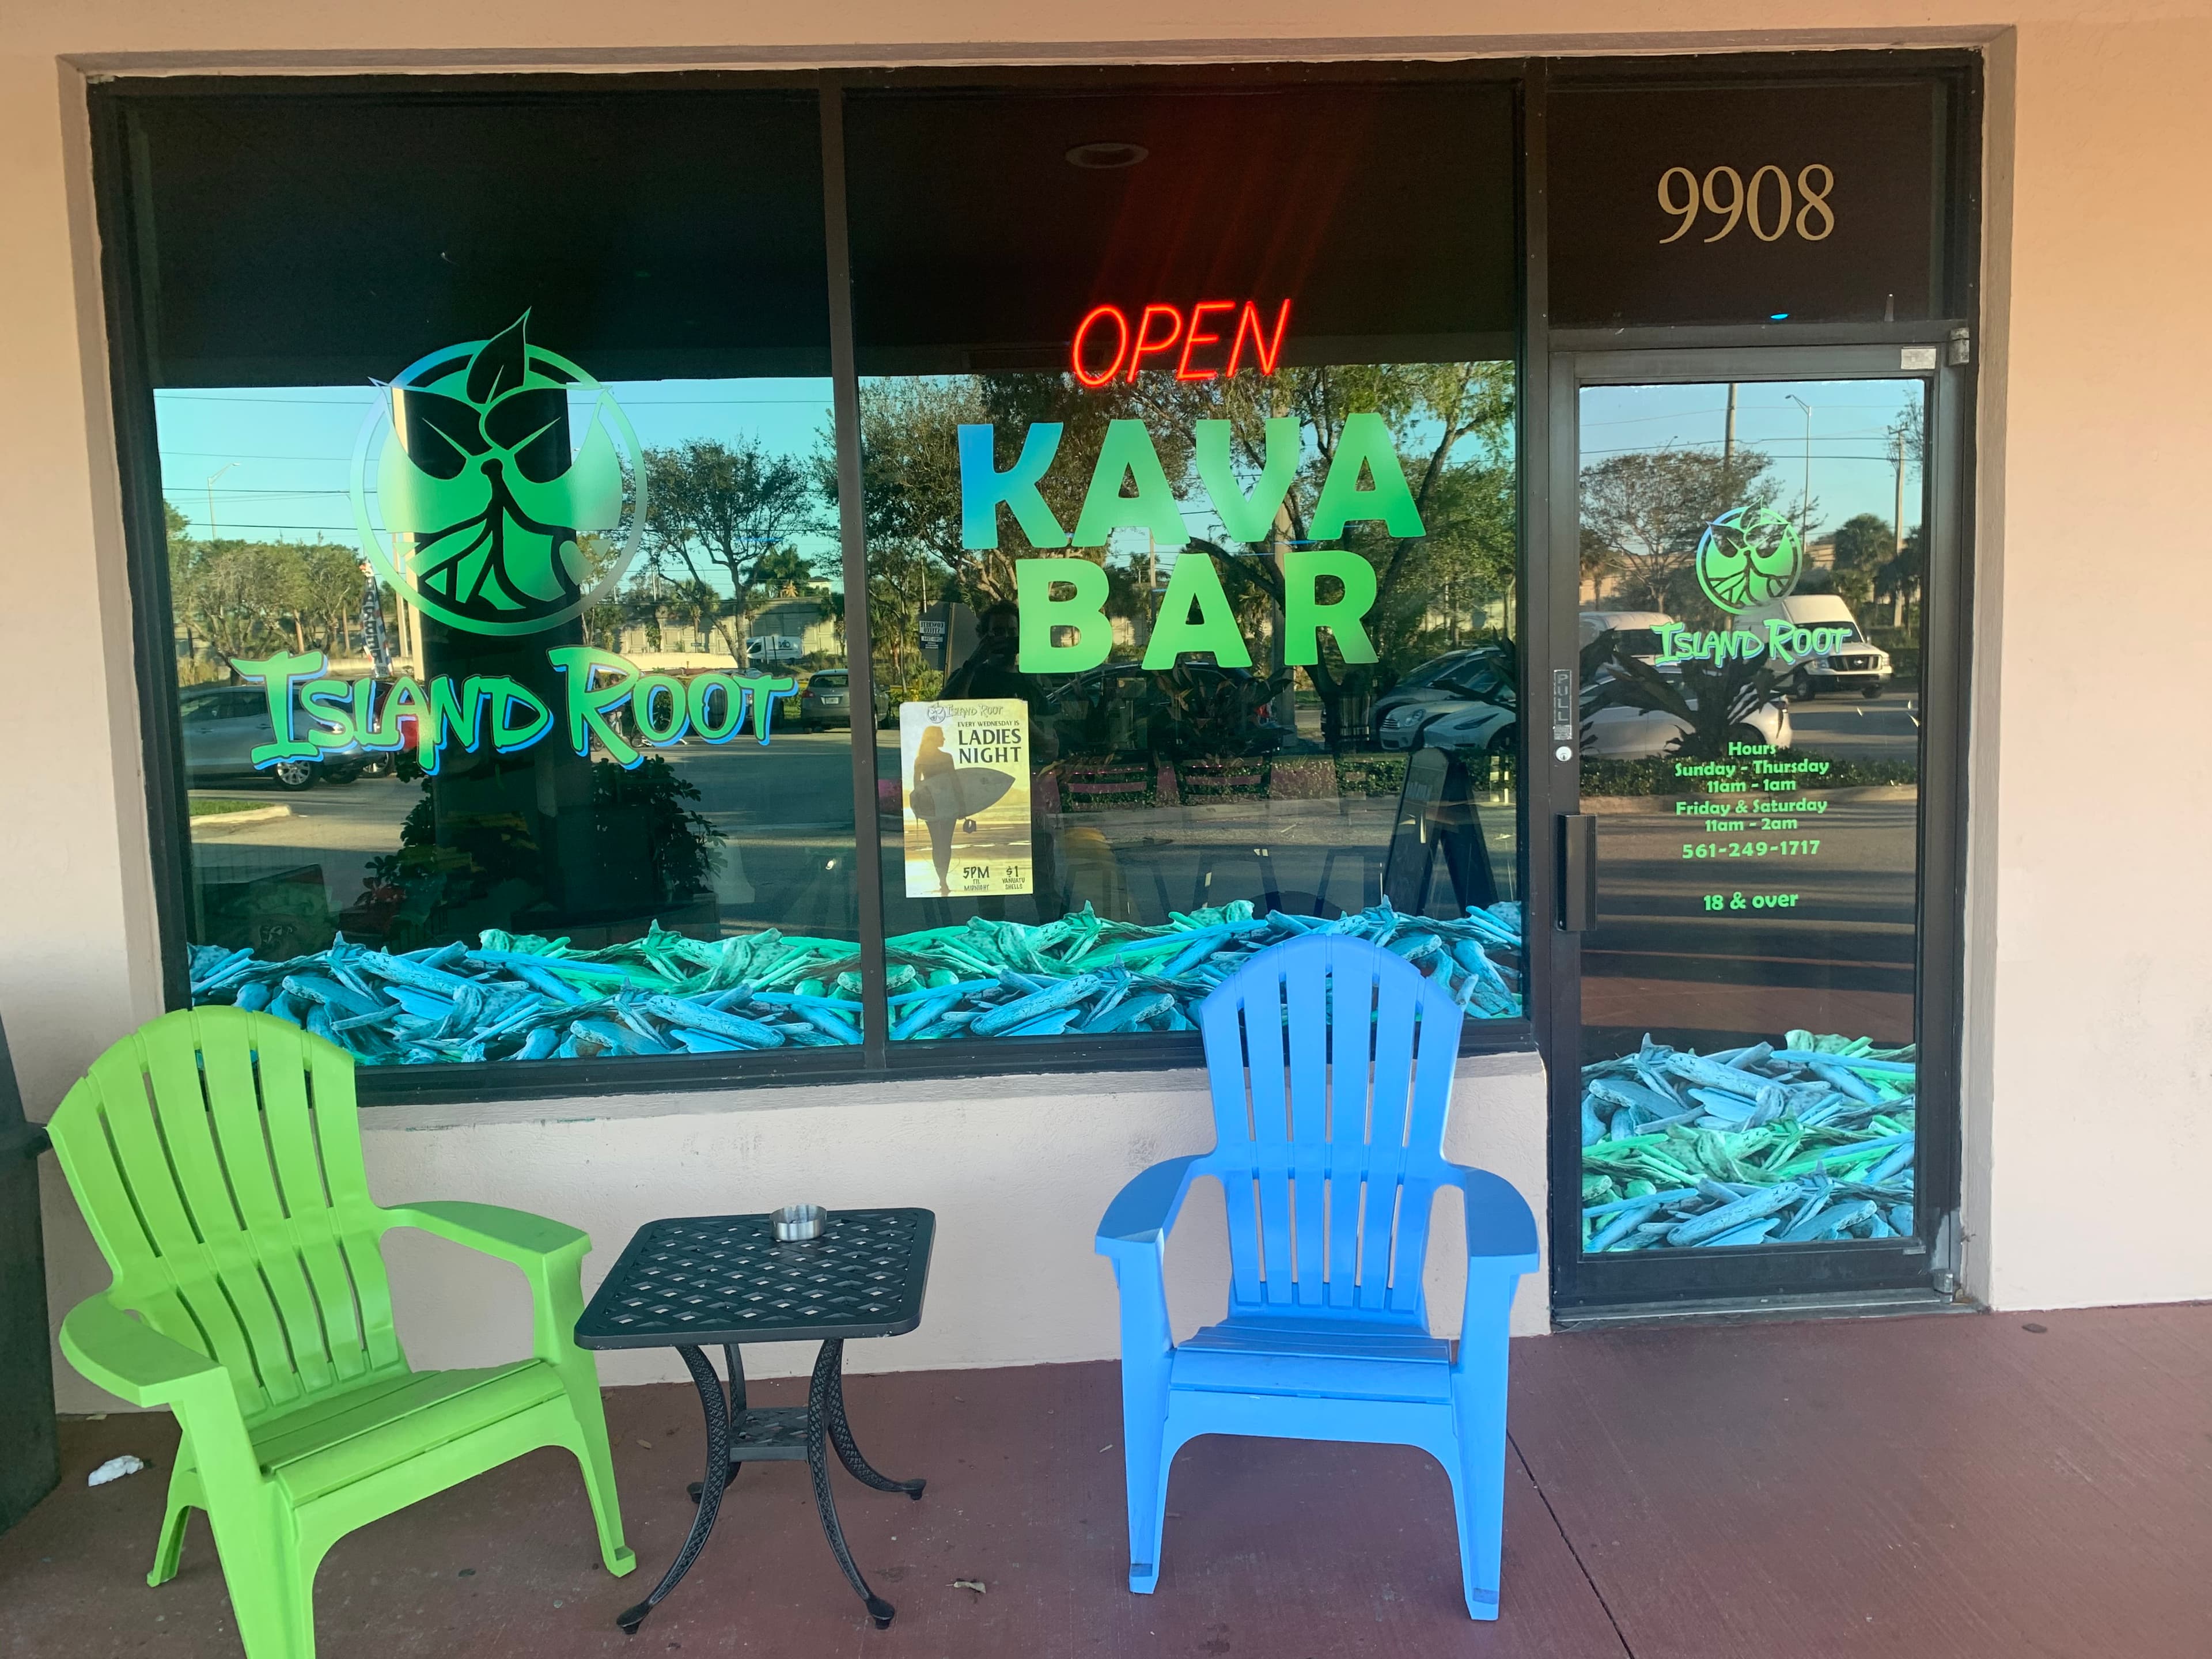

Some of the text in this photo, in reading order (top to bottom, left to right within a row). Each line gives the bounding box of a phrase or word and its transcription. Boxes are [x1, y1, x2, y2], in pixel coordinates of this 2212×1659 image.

[1657, 163, 1835, 244] 9908
[1071, 298, 1291, 388] OPEN
[957, 412, 1427, 550] KAVA
[1015, 550, 1380, 673] BAR
[1649, 619, 1853, 668] ISLAND ROOT
[1557, 673, 1569, 722] PULL
[230, 644, 799, 776] ISLAND ROOT
[979, 704, 1003, 718] ROOT
[959, 729, 1021, 745] LADIES
[959, 747, 1021, 764] NIGHT
[1728, 742, 1776, 756] Hours
[1675, 761, 1736, 778] Sunday
[1752, 758, 1830, 775] Thursday
[1707, 781, 1746, 793] 11am
[1763, 778, 1796, 791] 1am
[1676, 797, 1828, 817] Friday & Saturday
[1705, 820, 1744, 832] 11am
[1761, 818, 1797, 830] 2am
[1682, 840, 1820, 859] 561-249-1717
[963, 866, 990, 878] 5PM
[1006, 865, 1018, 877] $1
[1703, 892, 1798, 911] 18 & over
